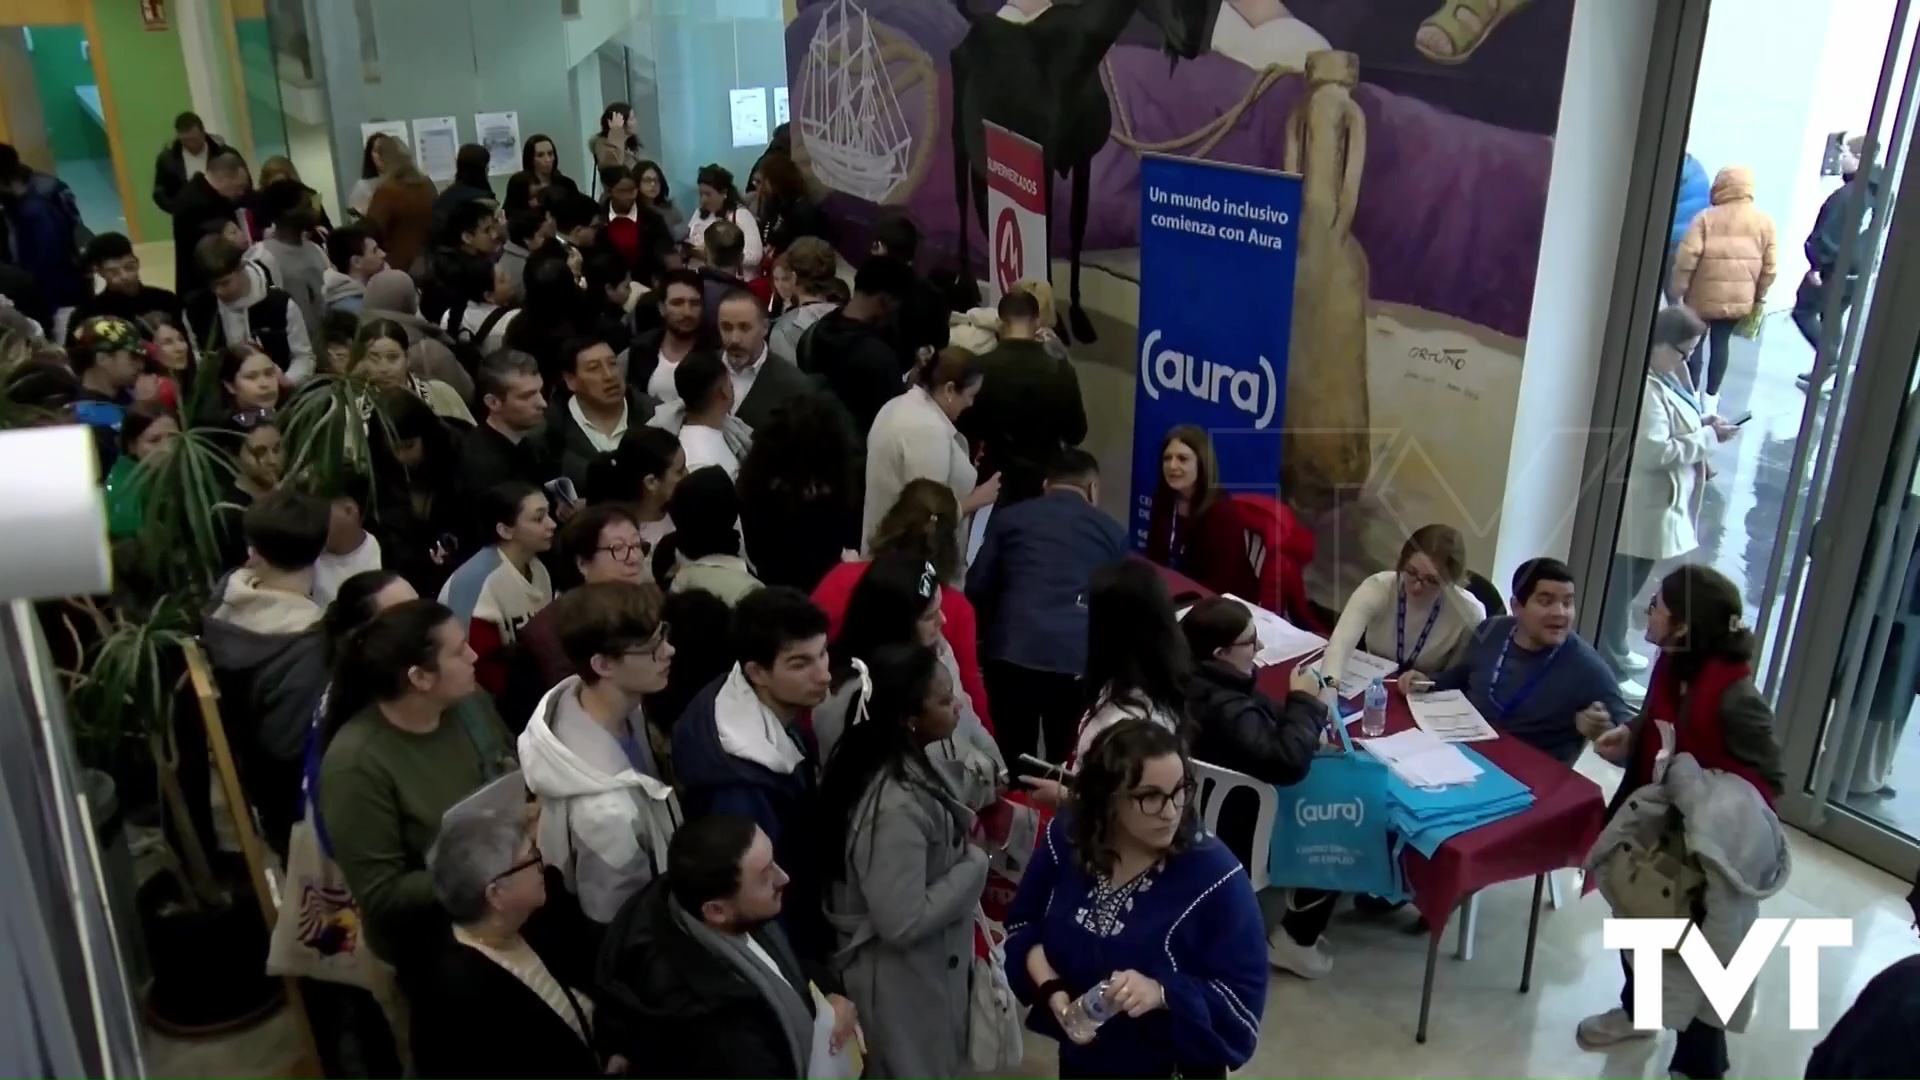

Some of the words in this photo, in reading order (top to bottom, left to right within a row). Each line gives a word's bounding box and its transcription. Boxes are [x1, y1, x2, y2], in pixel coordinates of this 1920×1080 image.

[987, 156, 1038, 196] SUPERMERCADOS
[1149, 186, 1168, 204] Un
[1170, 192, 1221, 213] mundo
[1223, 198, 1289, 225] inclusivo
[1150, 213, 1216, 237] comienza
[1218, 226, 1245, 242] con
[1248, 228, 1282, 250] Aura
